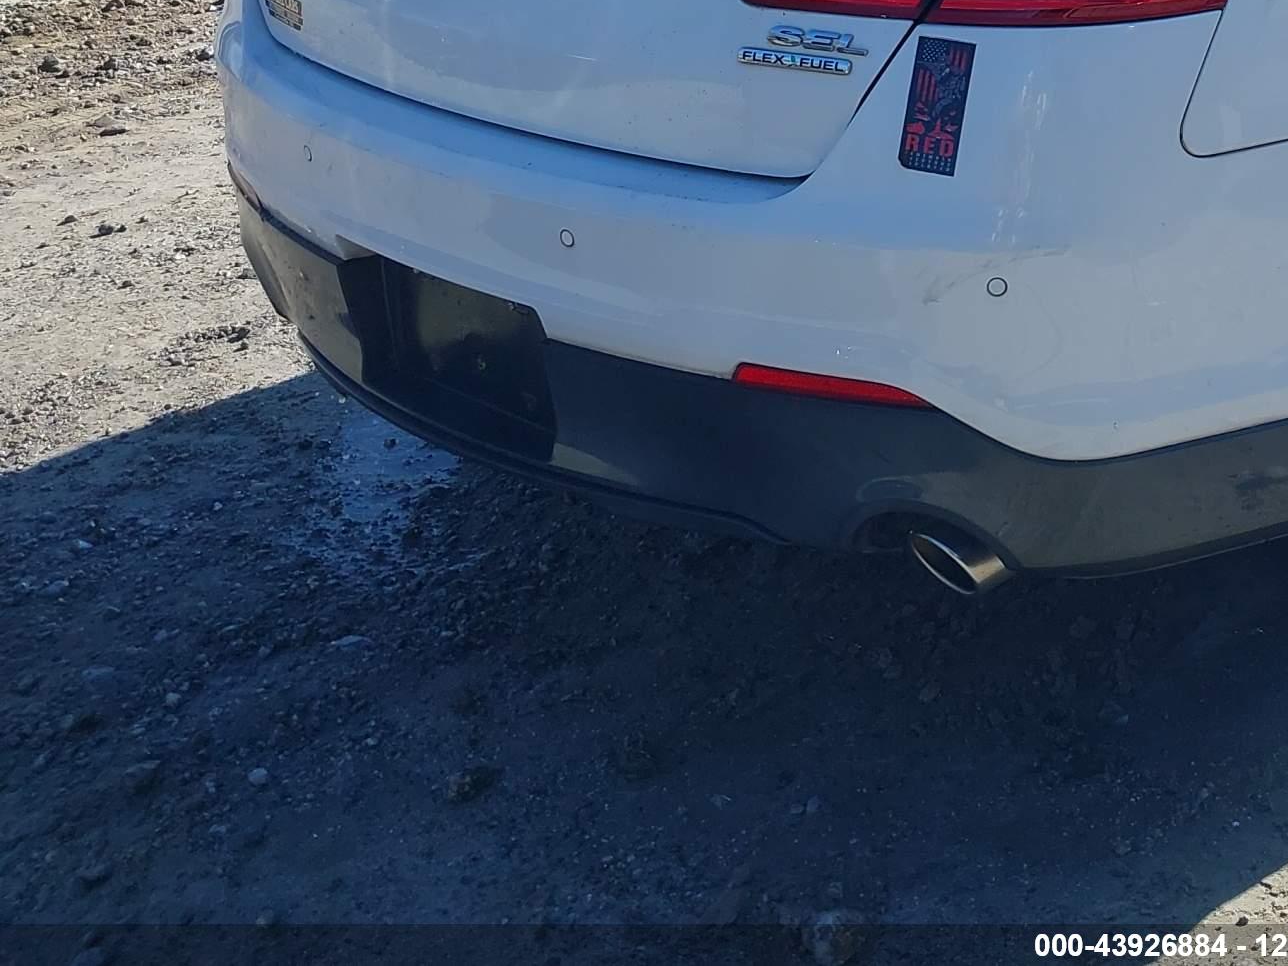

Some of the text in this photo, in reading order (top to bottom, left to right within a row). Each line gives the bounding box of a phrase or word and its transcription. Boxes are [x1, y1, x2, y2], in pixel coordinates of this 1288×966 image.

[767, 25, 869, 56] SEL
[743, 51, 844, 72] FLEX FUEL
[906, 133, 954, 158] RED
